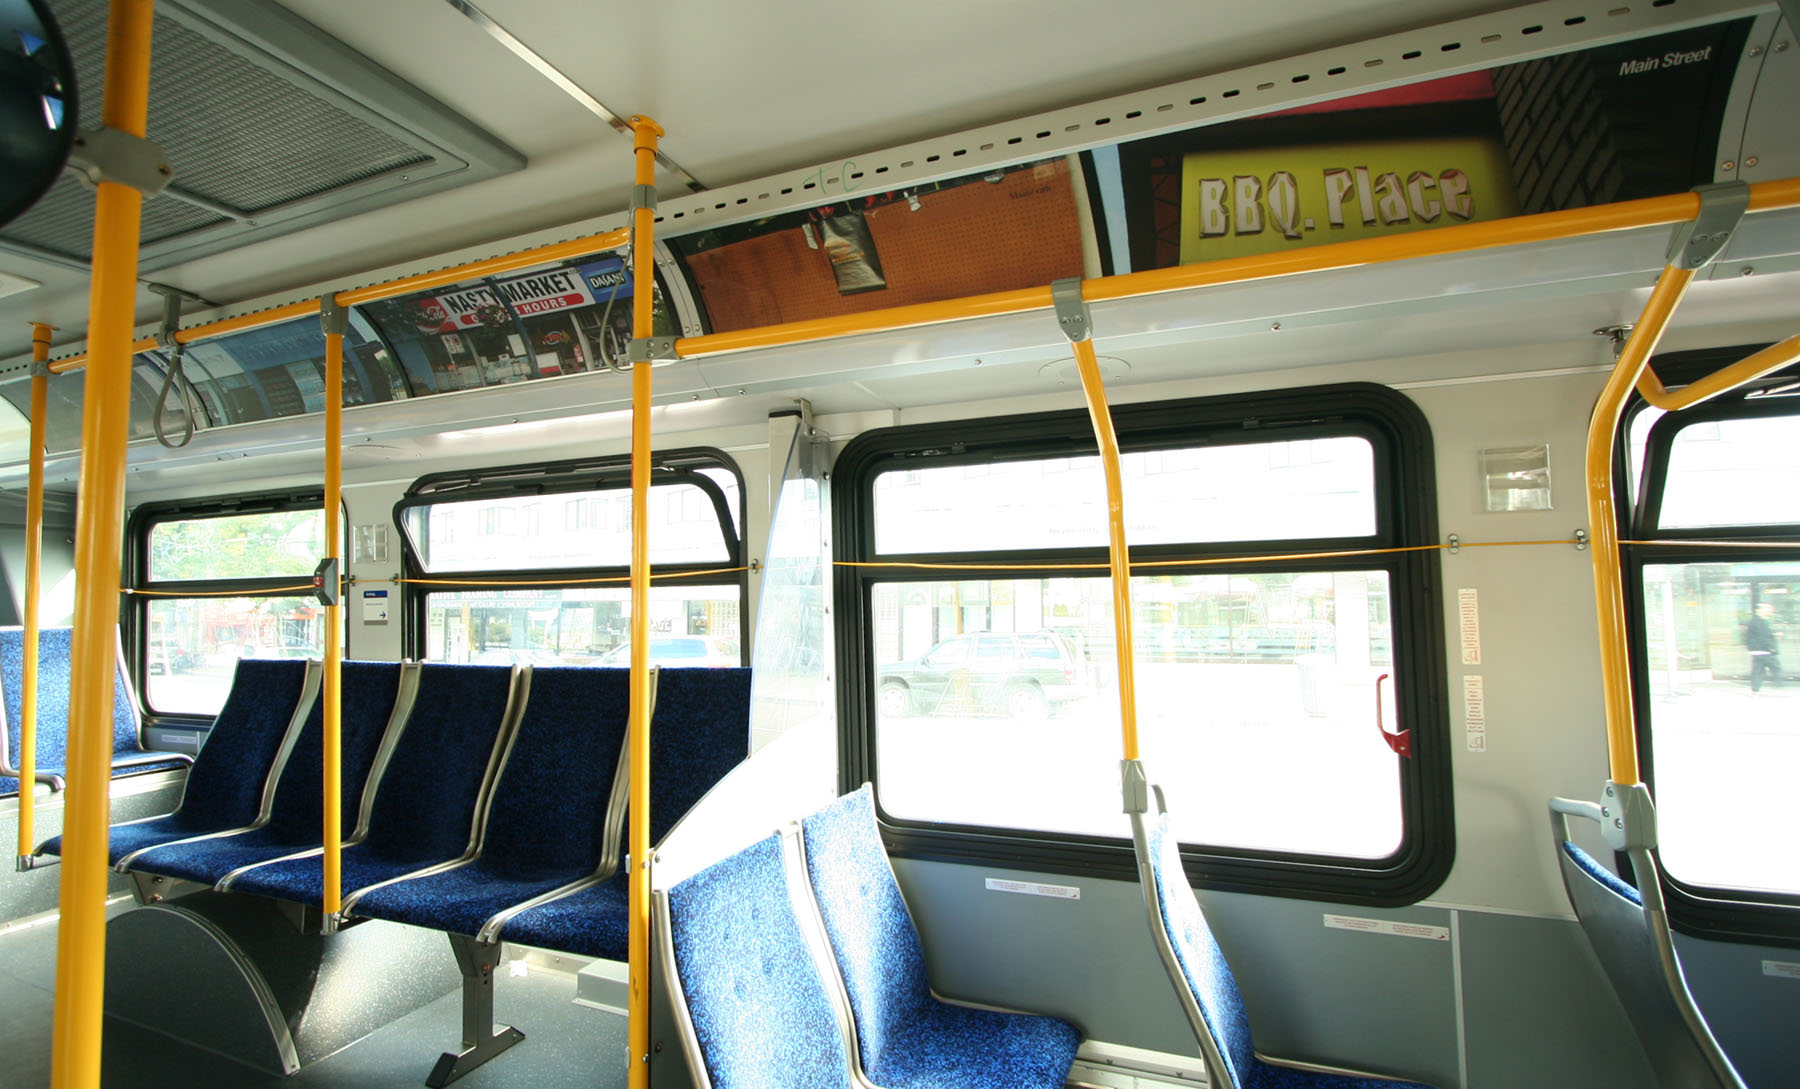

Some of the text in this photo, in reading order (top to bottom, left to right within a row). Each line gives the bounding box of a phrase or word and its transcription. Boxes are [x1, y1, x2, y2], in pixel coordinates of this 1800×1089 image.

[1619, 45, 1712, 76] Main Street
[1199, 166, 1475, 240] BBQ. Place
[444, 286, 498, 314] NASTY
[502, 271, 575, 303] MARKET
[523, 297, 567, 315] HOURS
